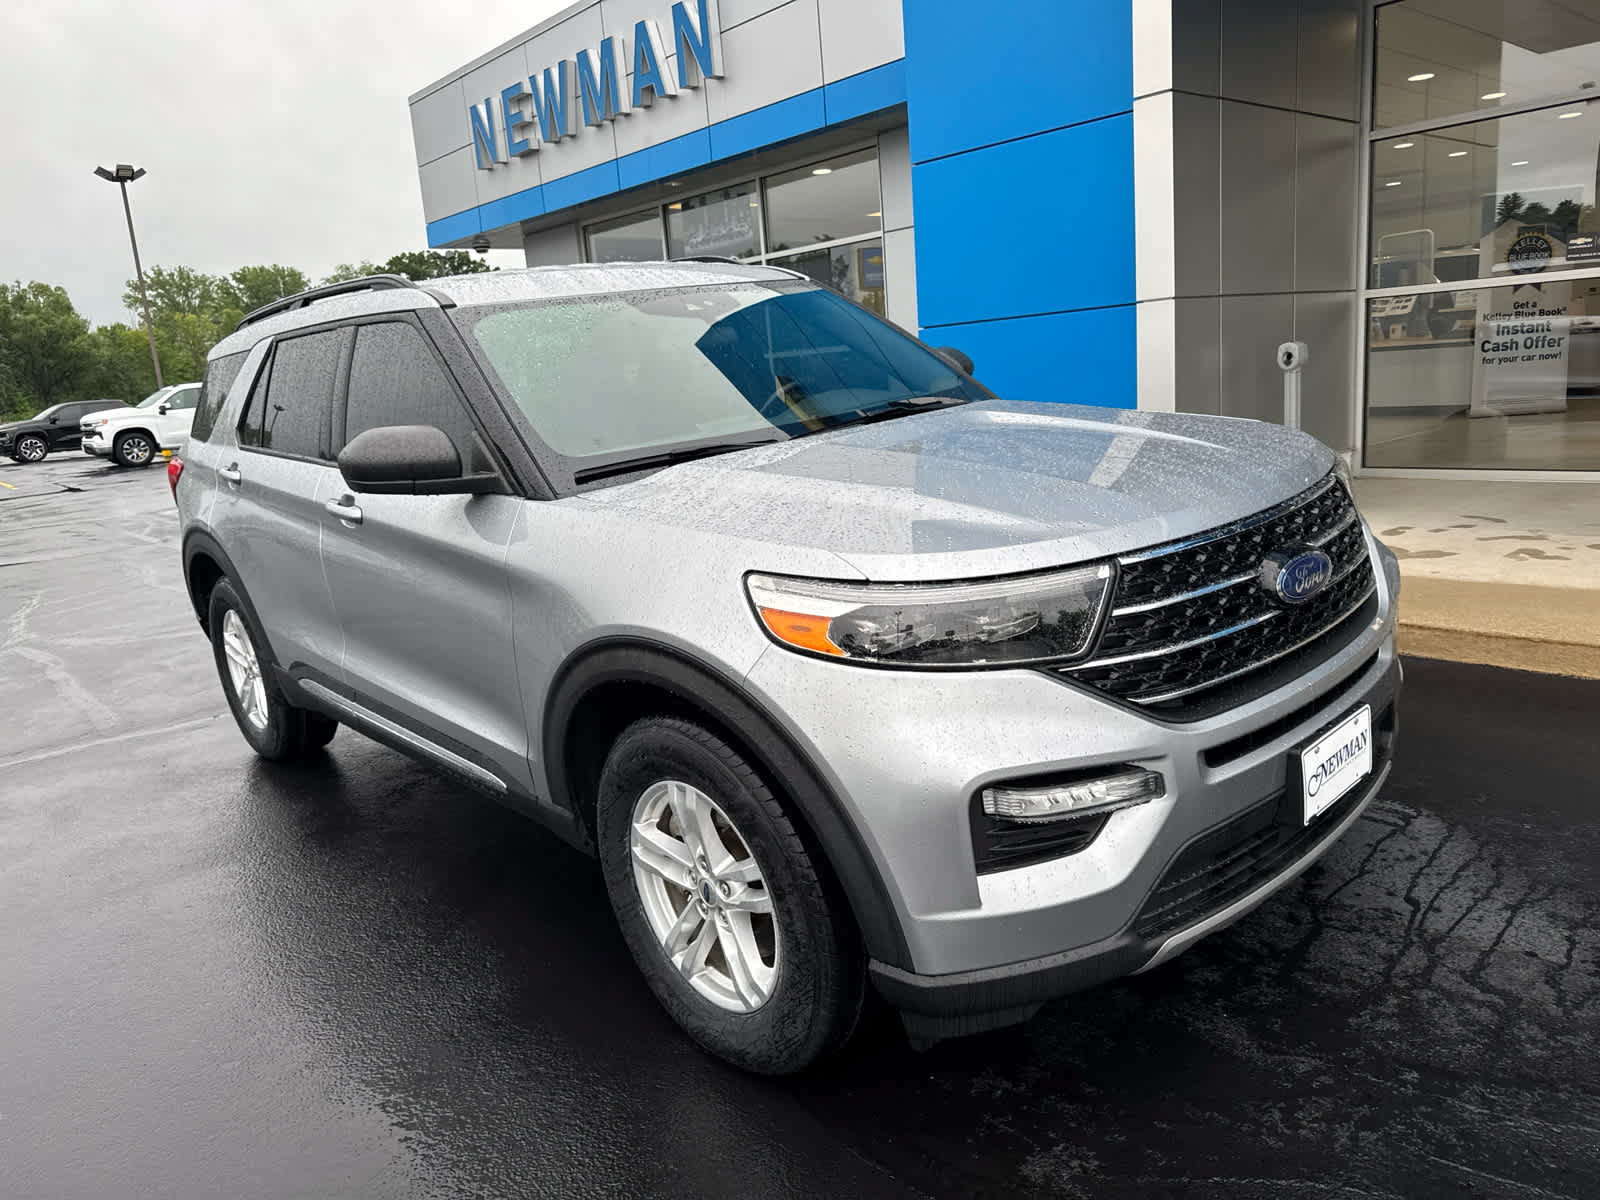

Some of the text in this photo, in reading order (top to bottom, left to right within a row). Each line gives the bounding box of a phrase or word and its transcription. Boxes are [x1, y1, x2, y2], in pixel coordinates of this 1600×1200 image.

[469, 0, 723, 170] NEWMAN
[1513, 237, 1548, 251] KELLEY
[1513, 301, 1530, 310] Get
[1483, 312, 1513, 322] Kelley
[1514, 310, 1536, 319] Blue
[1496, 320, 1552, 336] Instant
[1481, 335, 1565, 353] Cash Offer
[1482, 352, 1562, 365] for your car now!
[1295, 560, 1323, 593] Ford
[1308, 729, 1368, 797] NEWMAN
